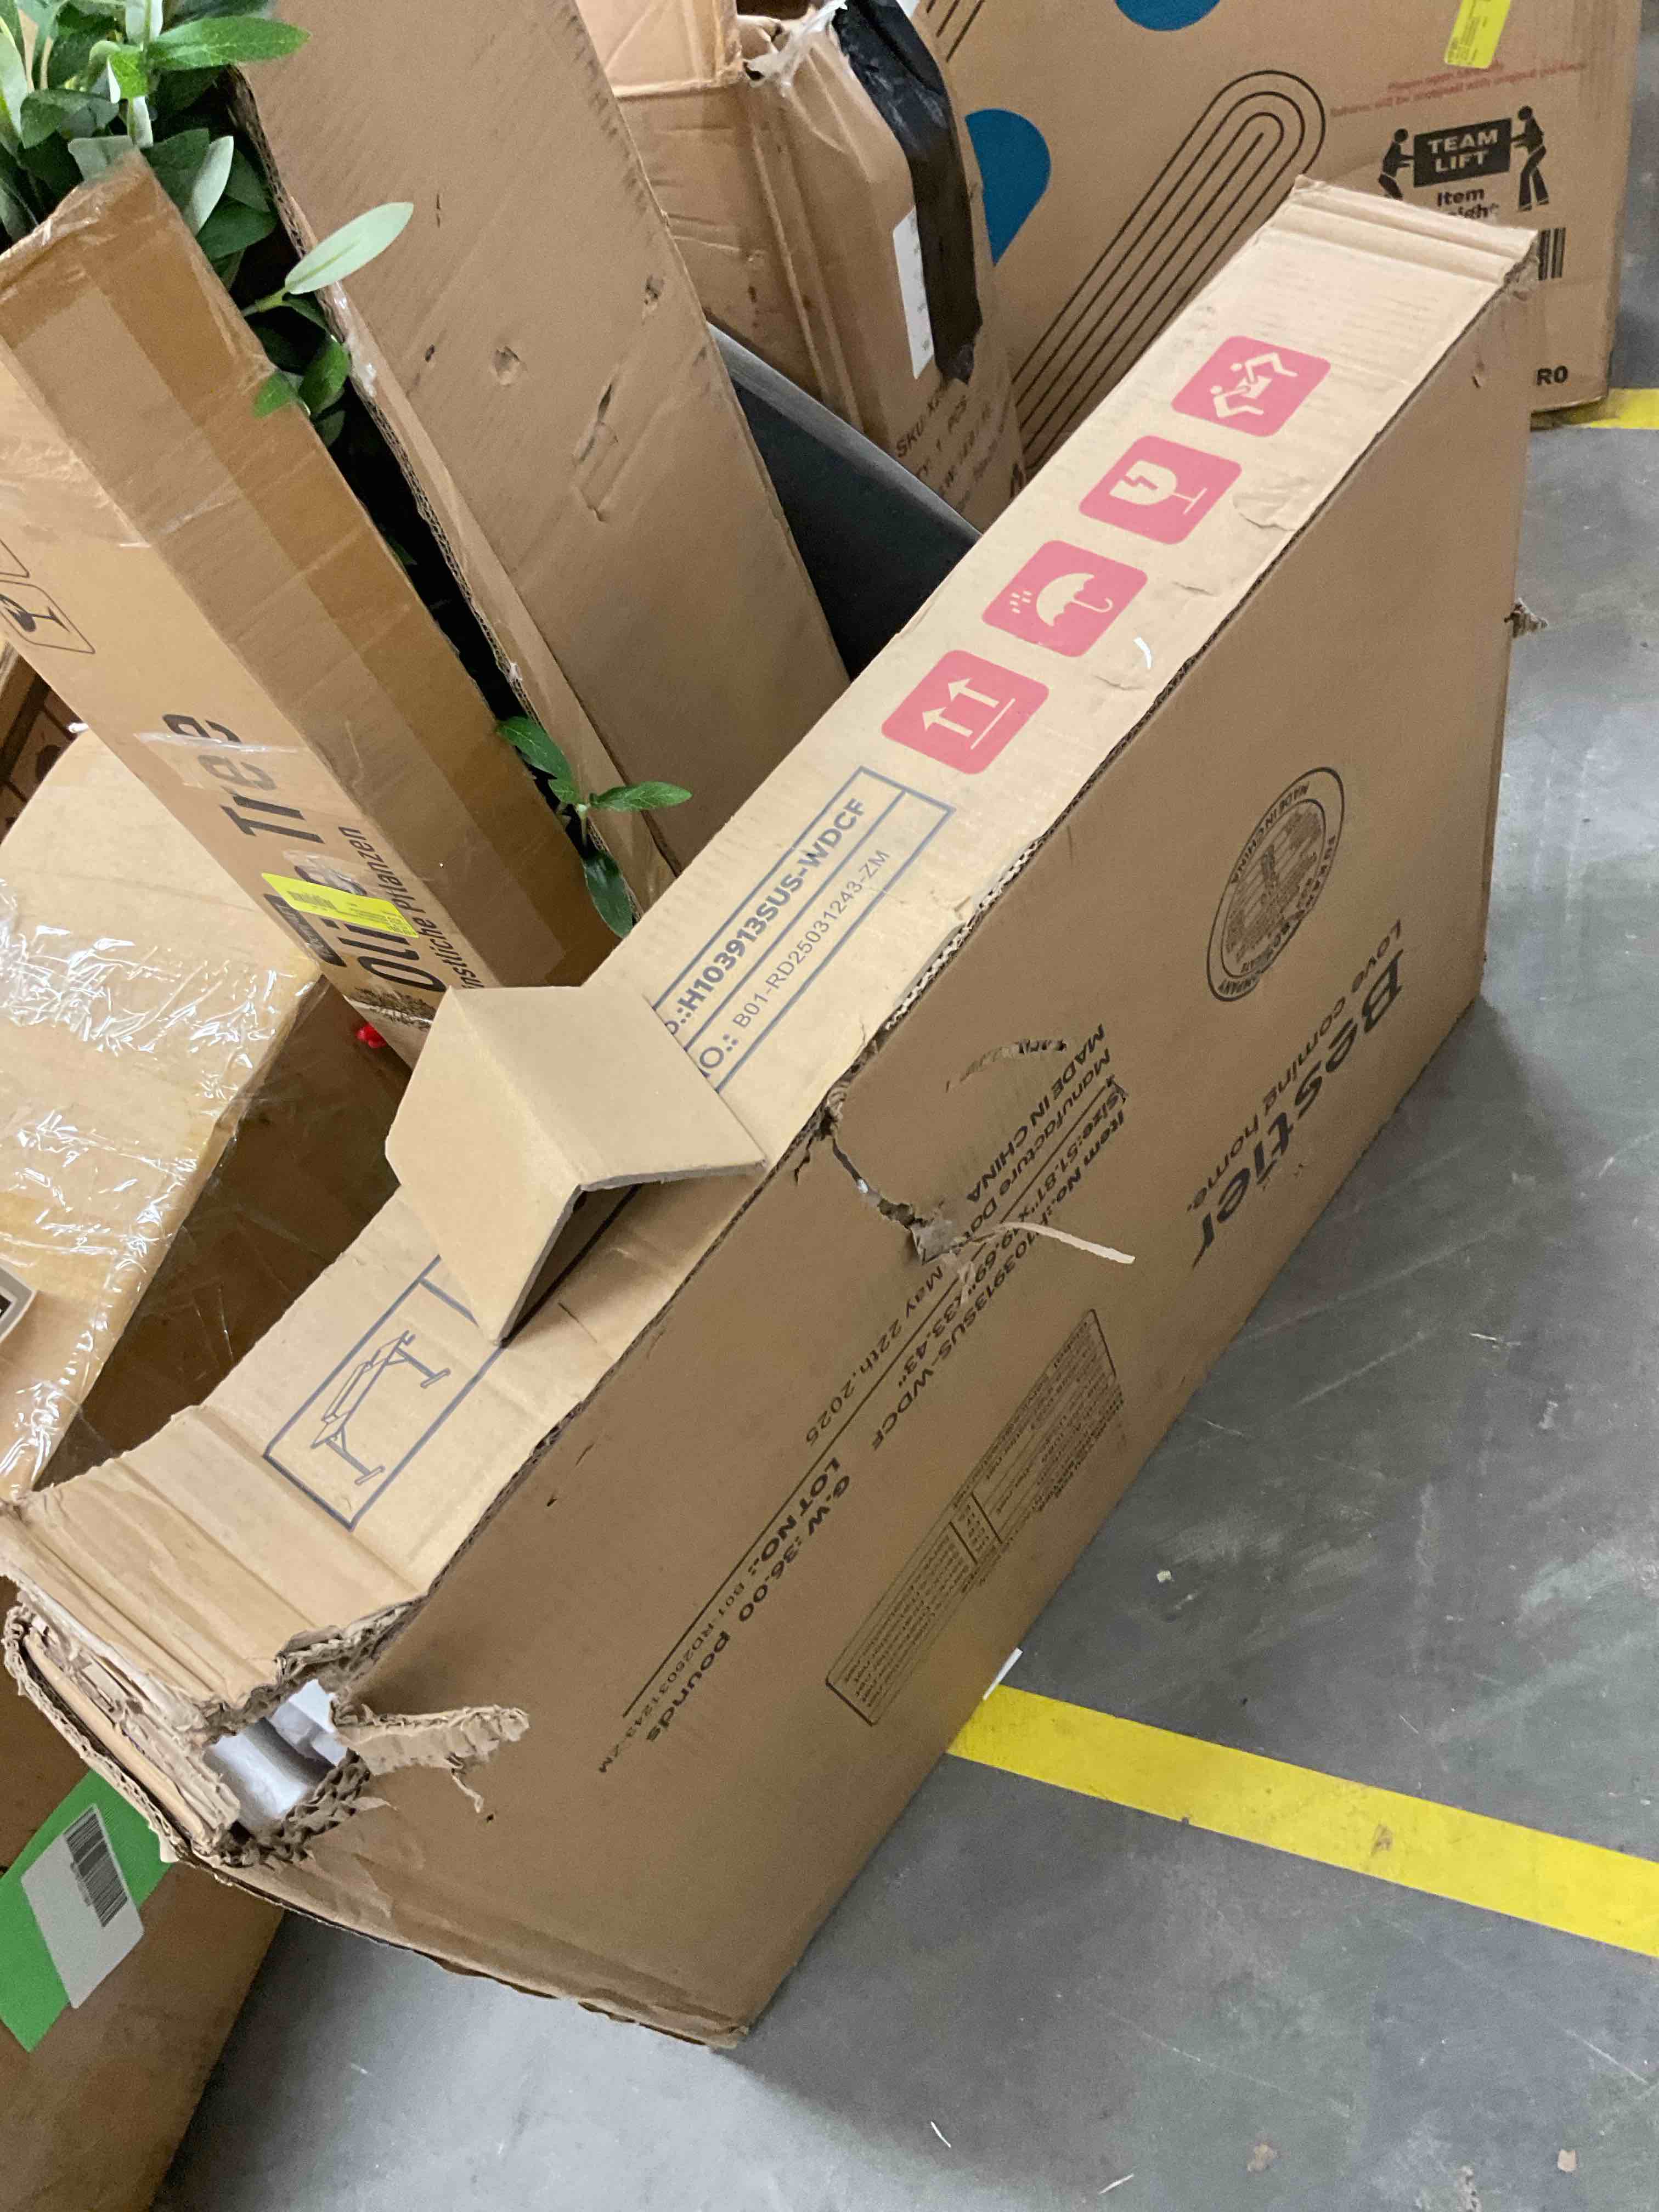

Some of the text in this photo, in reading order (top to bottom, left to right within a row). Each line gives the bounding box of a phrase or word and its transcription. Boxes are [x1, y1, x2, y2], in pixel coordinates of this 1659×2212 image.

[1427, 129, 1498, 154] TEAM
[1436, 149, 1489, 173] LIFT
[1437, 189, 1484, 207] Item
[163, 714, 325, 844] Tree
[665, 797, 867, 1035] o.:H103913SUS-WDCF
[1351, 919, 1402, 994] Love
[699, 850, 890, 1078] O.: B01-RD25031243-ZM
[1261, 996, 1347, 1111] coming
[967, 1023, 1105, 1202] MADE IN CHINA
[1000, 1047, 1110, 1195] Manufacture
[1084, 1110, 1124, 1166] Item
[1186, 1116, 1260, 1212] home.
[906, 1266, 943, 1318] May
[799, 1457, 840, 1519] LOT
[749, 1515, 795, 1576] NO.:
[646, 1630, 731, 1742] pounds
